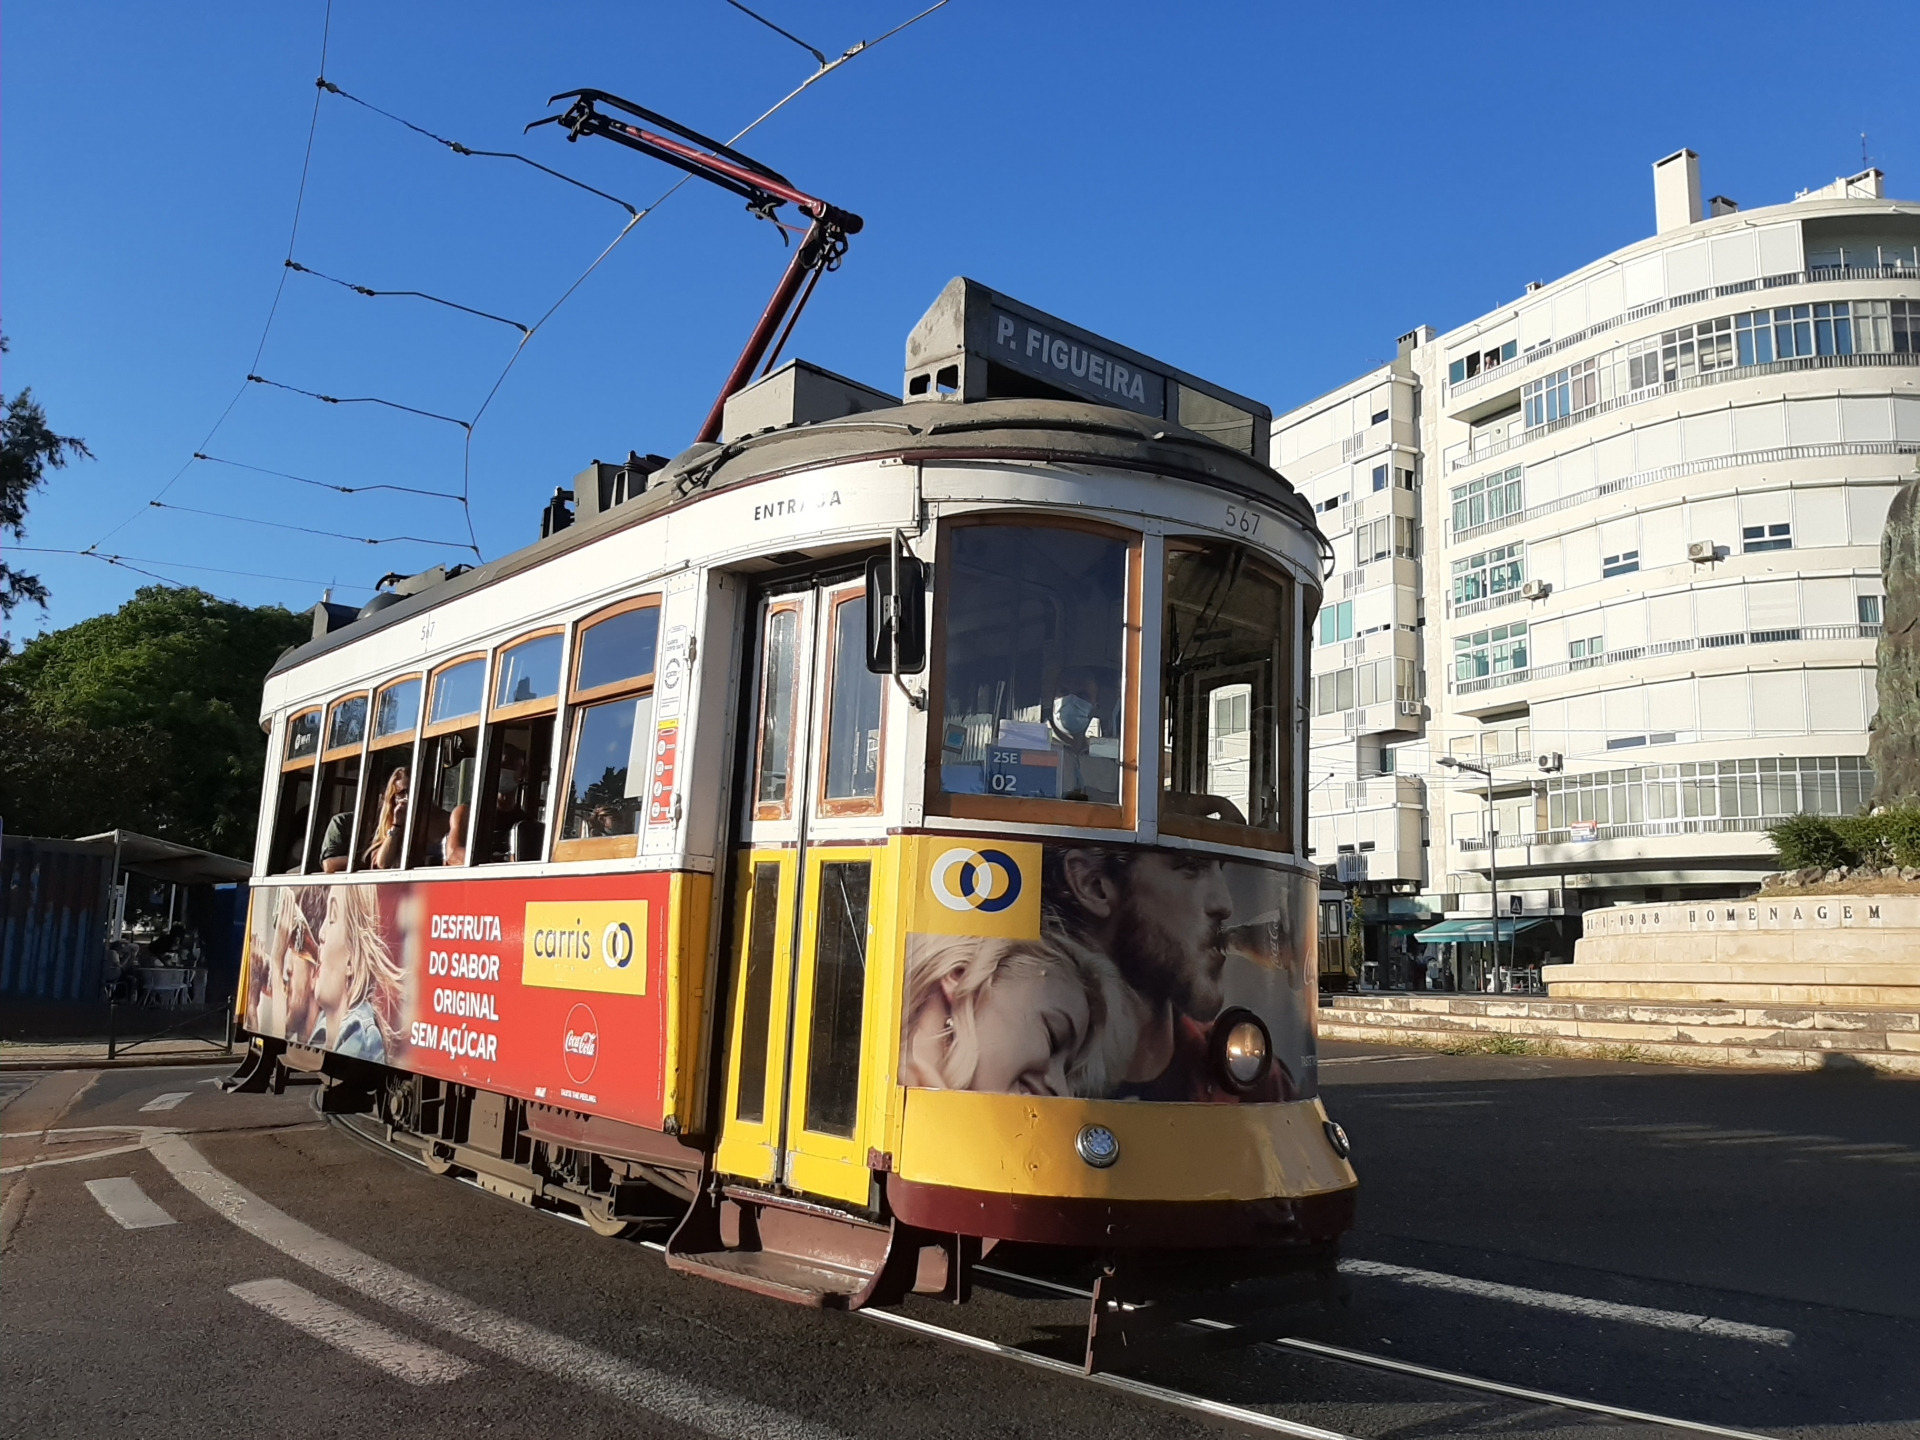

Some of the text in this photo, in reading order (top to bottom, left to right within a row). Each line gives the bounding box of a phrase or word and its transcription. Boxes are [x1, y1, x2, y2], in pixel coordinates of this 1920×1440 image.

[996, 314, 1145, 404] P. FIGUEIRA
[1225, 504, 1261, 535] 567
[993, 751, 1018, 764] 25E
[992, 773, 1017, 792] 02
[431, 914, 501, 941] DESFRUTA
[1688, 905, 1881, 923] HOMENAGEM
[534, 917, 591, 960] carris
[428, 950, 500, 981] DO SABOR
[433, 987, 499, 1021] ORIGINAL
[410, 1021, 497, 1062] SEM AÇÚCAR
